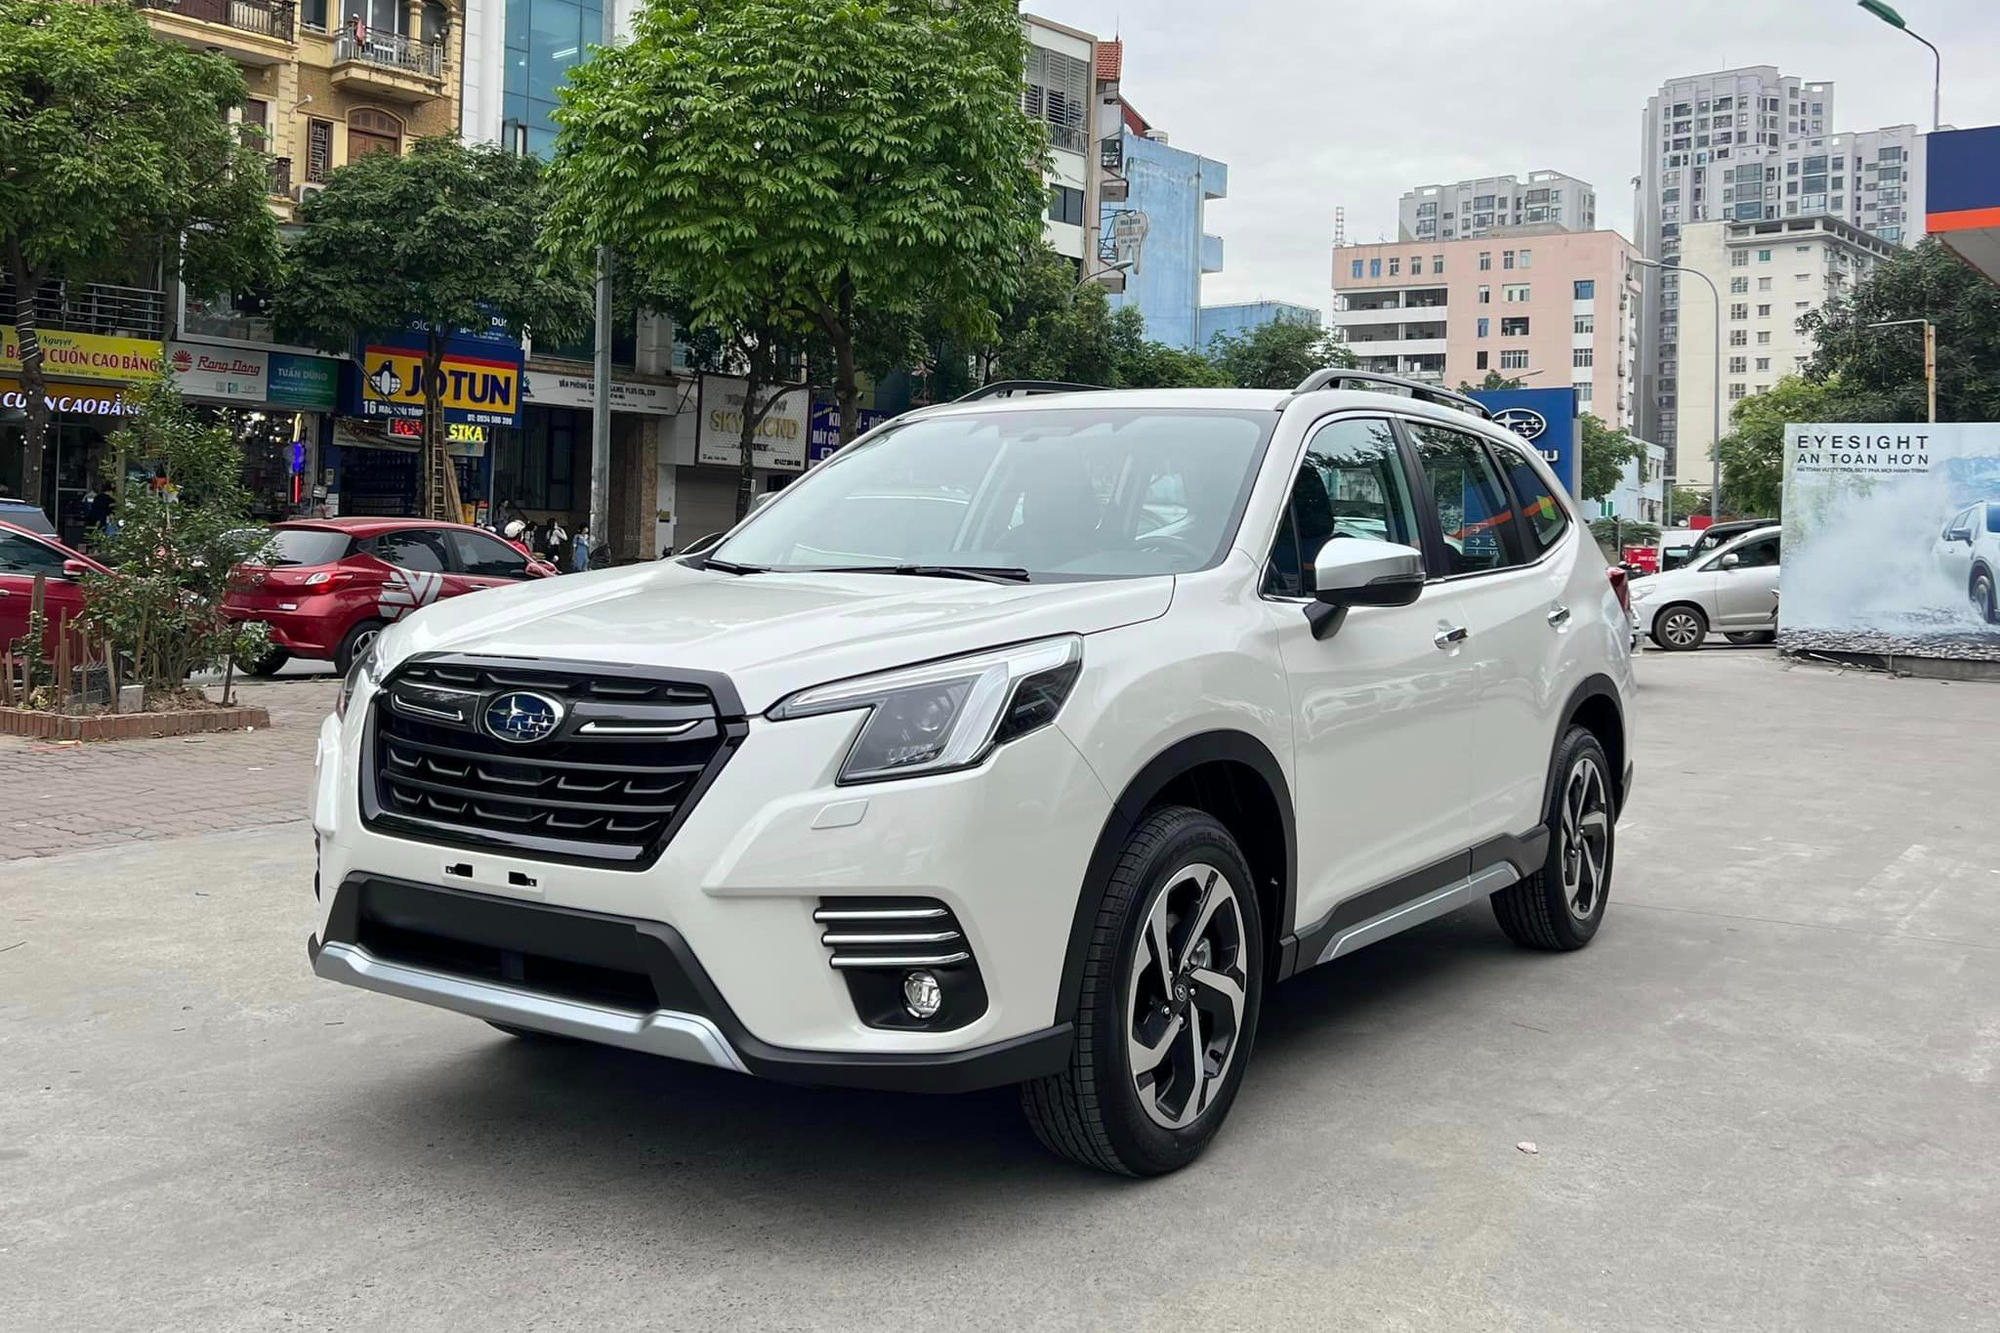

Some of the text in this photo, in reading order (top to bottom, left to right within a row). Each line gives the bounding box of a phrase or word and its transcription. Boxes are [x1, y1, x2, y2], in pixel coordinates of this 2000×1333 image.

[92, 352, 118, 368] CAO
[58, 397, 96, 414] CAO
[363, 400, 376, 414] 16
[449, 424, 484, 442] SIKA
[1797, 435, 1929, 450] EYESIGHT
[1797, 451, 1929, 465] AN TOÀN HƠN
